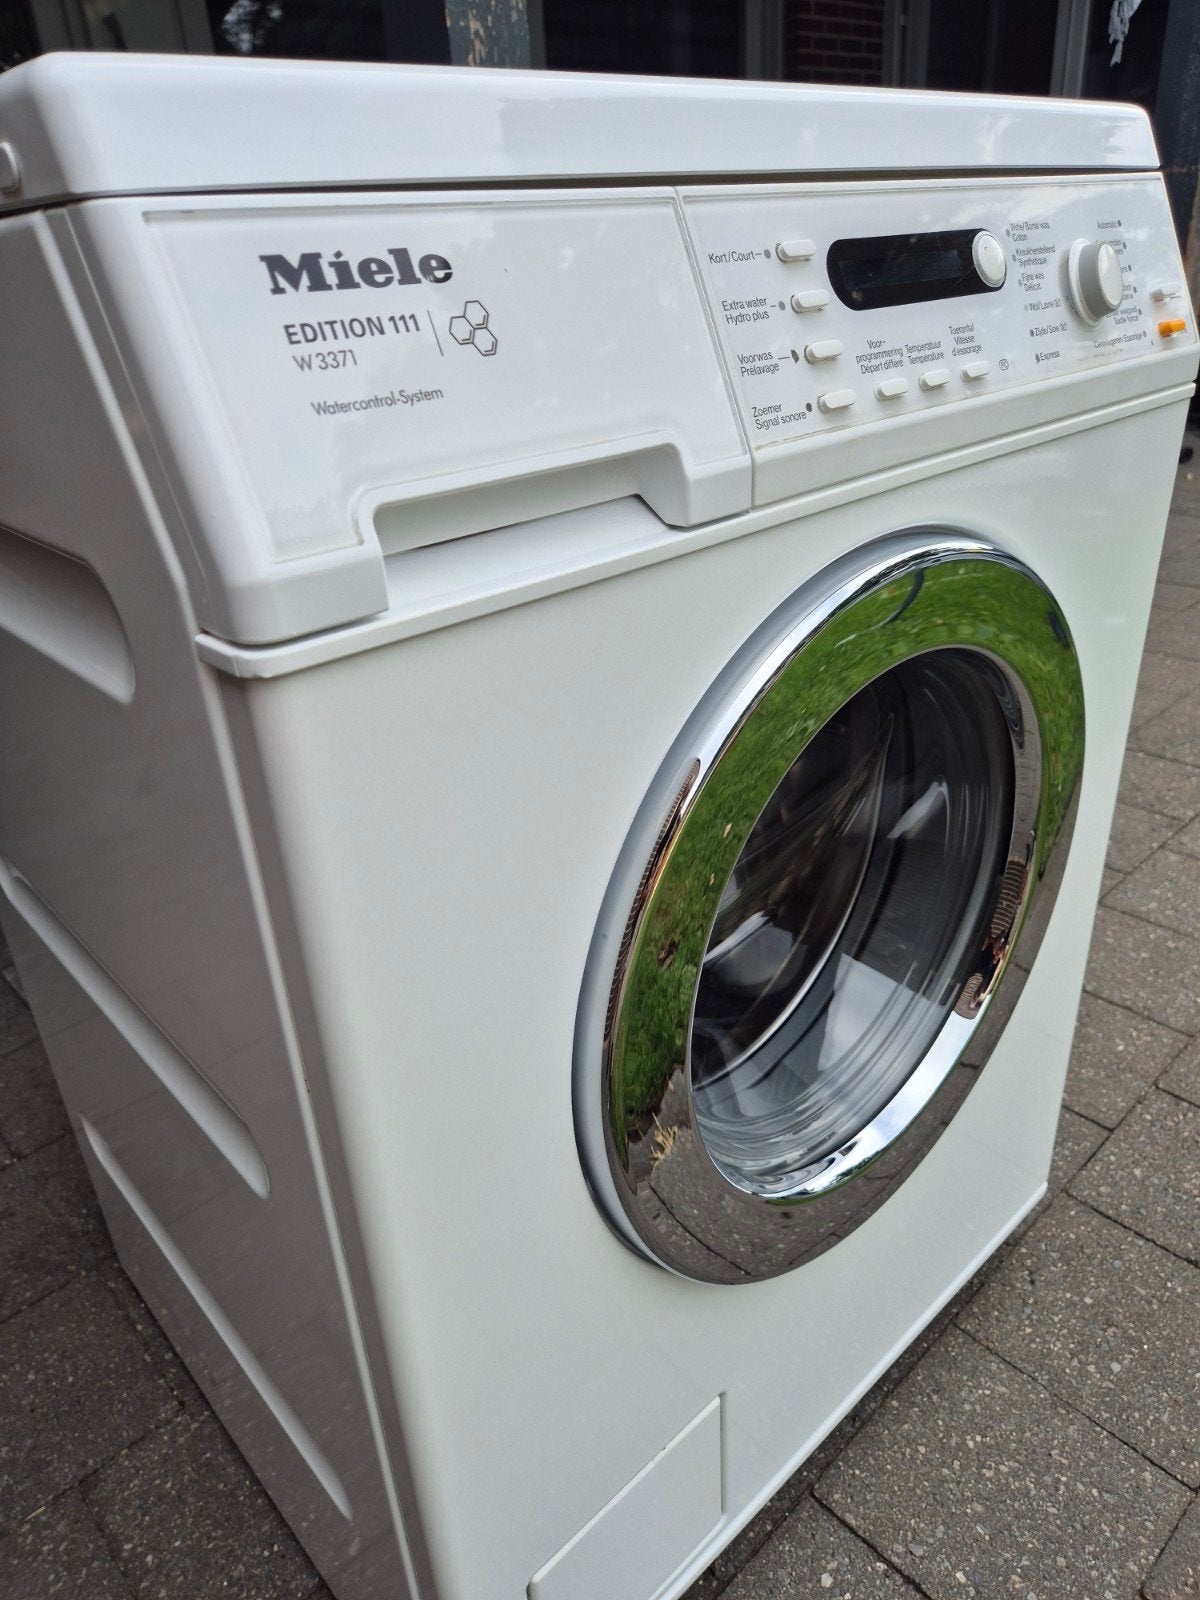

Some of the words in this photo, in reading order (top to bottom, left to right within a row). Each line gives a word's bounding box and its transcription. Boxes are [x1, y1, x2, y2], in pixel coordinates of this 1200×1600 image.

[258, 247, 453, 294] Miele
[722, 300, 745, 311] Extra
[745, 297, 767, 308] water
[725, 312, 751, 325] Hydro
[752, 310, 770, 323] plus
[283, 316, 386, 345] EDITION
[388, 313, 421, 334] 111
[949, 322, 975, 336] Toerental
[905, 340, 942, 354] Temperatuur
[954, 334, 976, 346] Vitesse
[292, 353, 313, 372] W
[315, 349, 358, 370] 3371
[737, 351, 774, 364] Voorwas
[855, 347, 904, 364] programmering
[740, 363, 780, 377] Prélavage
[860, 362, 883, 375] Départ
[310, 387, 444, 417] Watercontrol-System
[752, 404, 783, 418] Zoemer
[755, 417, 780, 431] Signal
[780, 411, 807, 423] sonore
